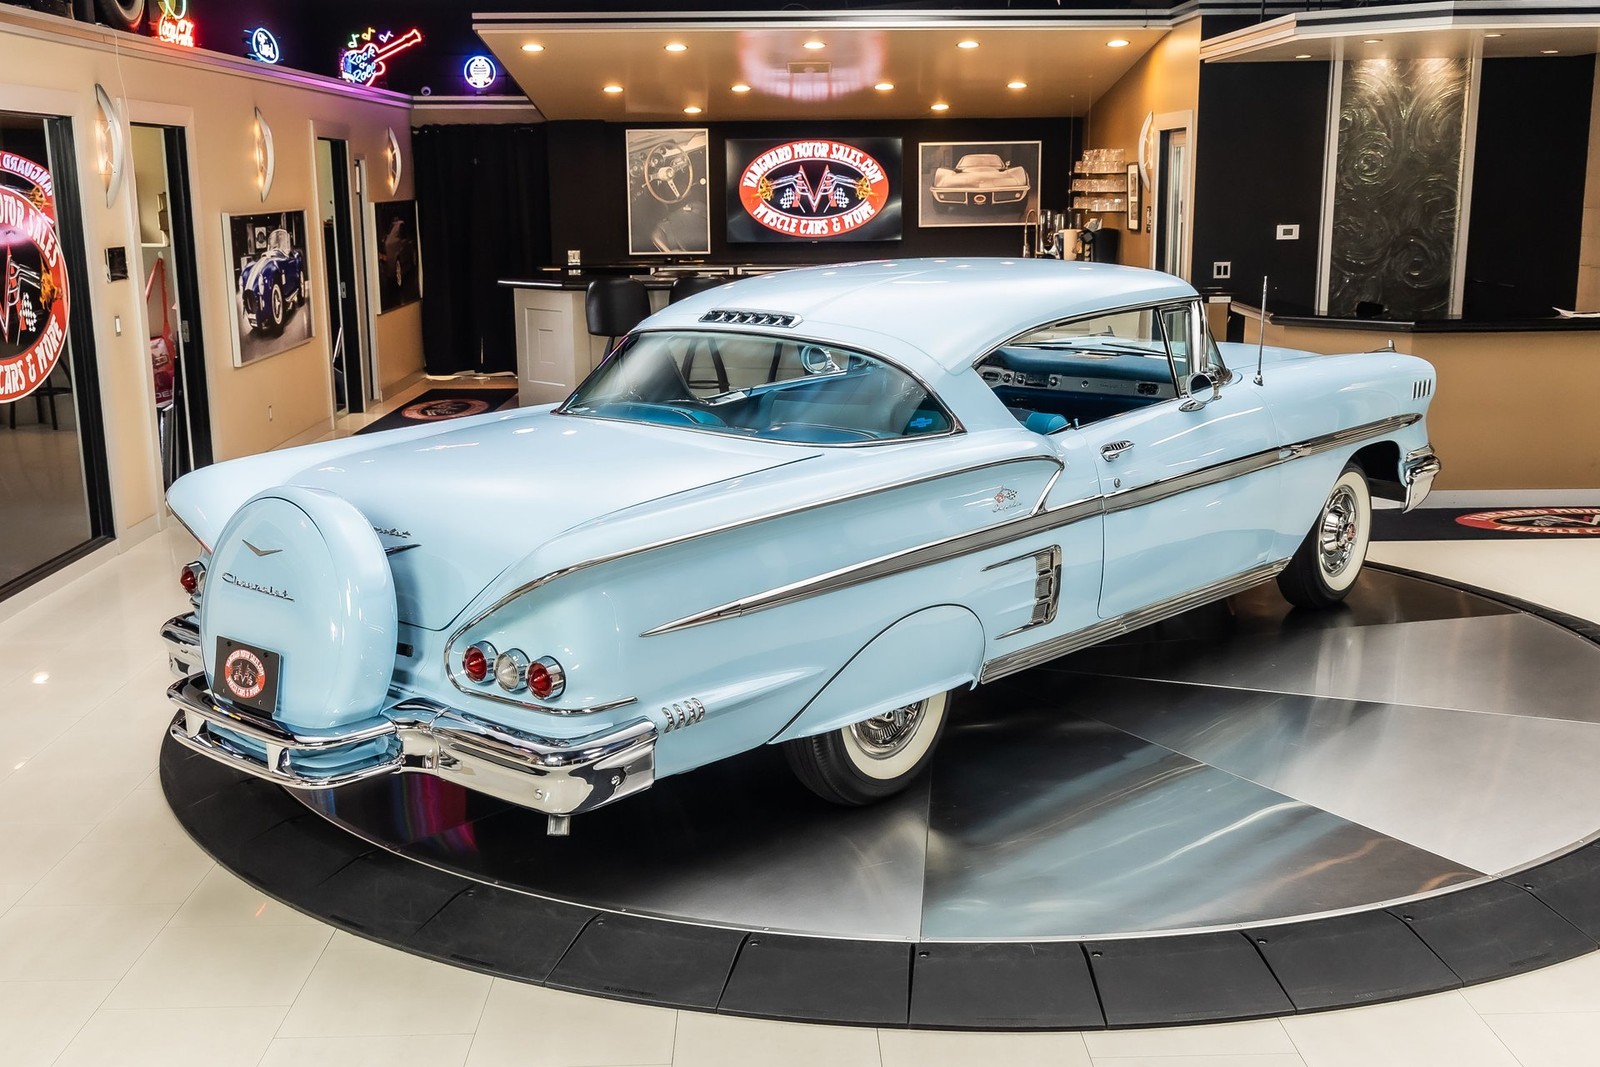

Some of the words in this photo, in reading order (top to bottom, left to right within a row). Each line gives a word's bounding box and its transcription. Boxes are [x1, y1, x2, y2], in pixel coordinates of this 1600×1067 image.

[349, 45, 376, 65] Rock
[352, 61, 377, 83] Roll
[743, 145, 793, 188] VANGUARD
[793, 141, 829, 159] MOTOR
[829, 143, 884, 184] SALES.COM
[752, 202, 800, 234] MUSCLE
[799, 219, 829, 235] CARS
[832, 218, 842, 232] &
[841, 200, 876, 230] MORE
[26, 207, 60, 268] SALES
[25, 352, 37, 383] &
[34, 313, 63, 375] MORE
[222, 572, 296, 602] Chevrolet
